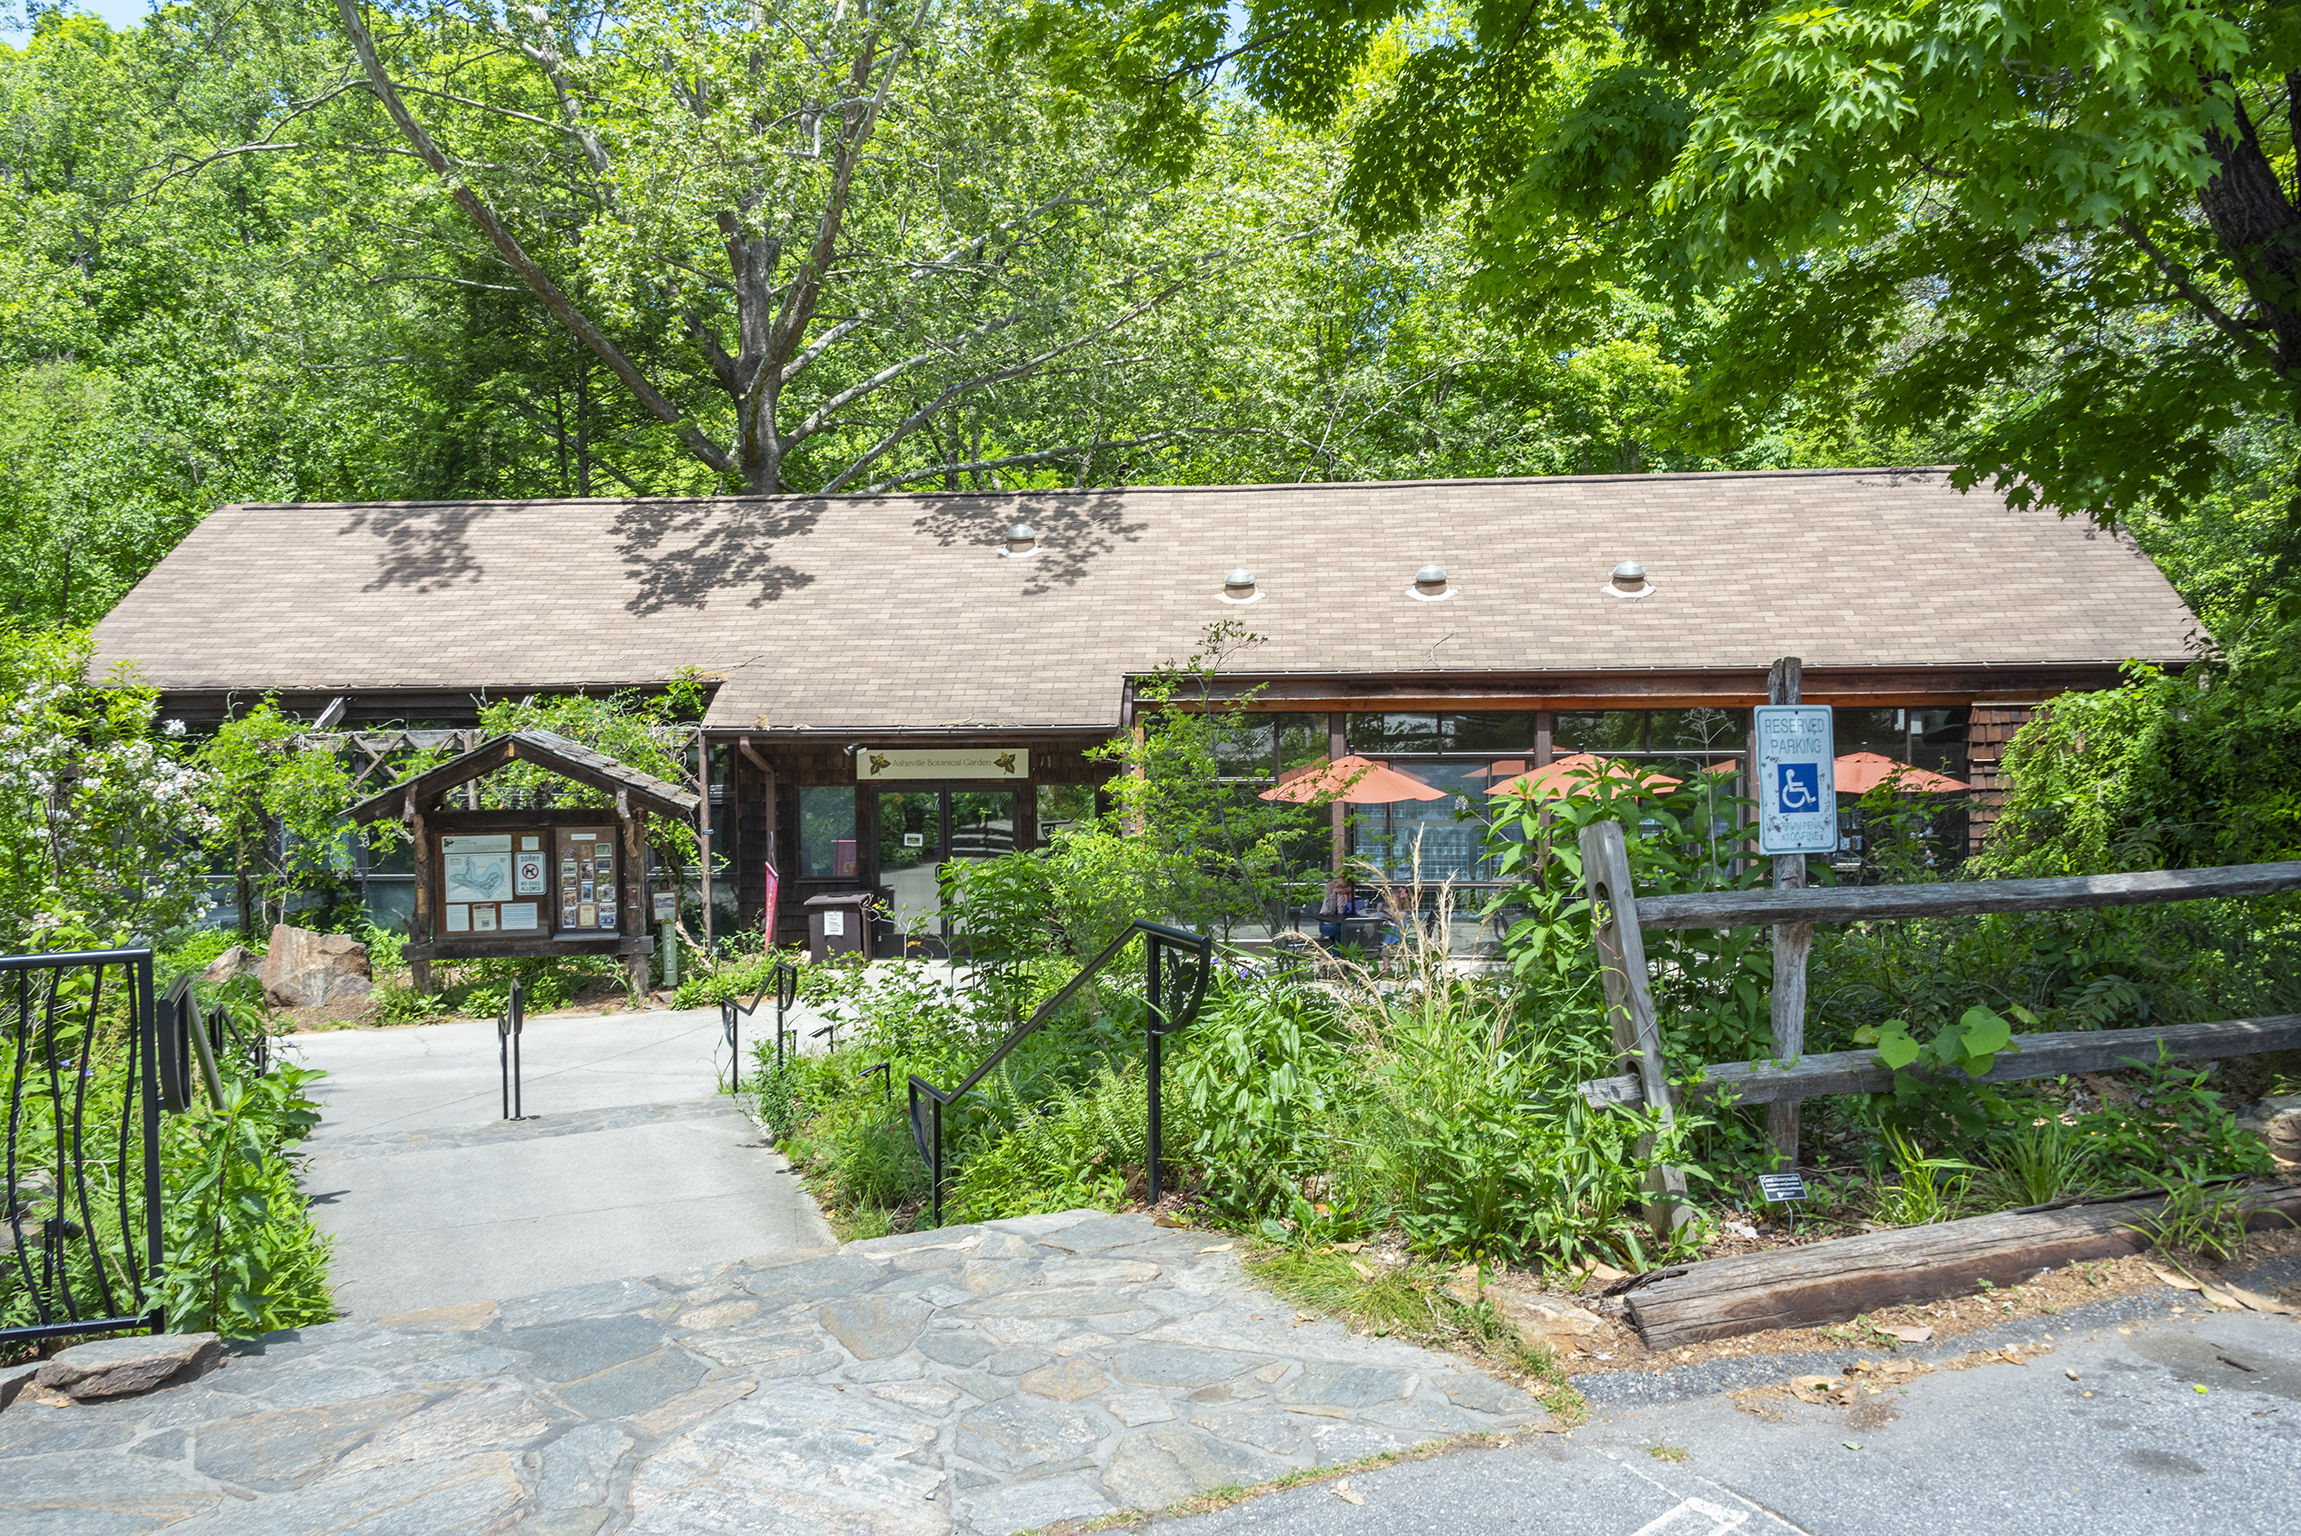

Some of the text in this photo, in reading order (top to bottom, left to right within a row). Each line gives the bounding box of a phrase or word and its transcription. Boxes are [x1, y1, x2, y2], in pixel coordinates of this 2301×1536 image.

[1765, 718, 1824, 733] RESERVED
[1771, 738, 1822, 753] PARKING
[892, 758, 992, 767] Asheville Botanical Garden
